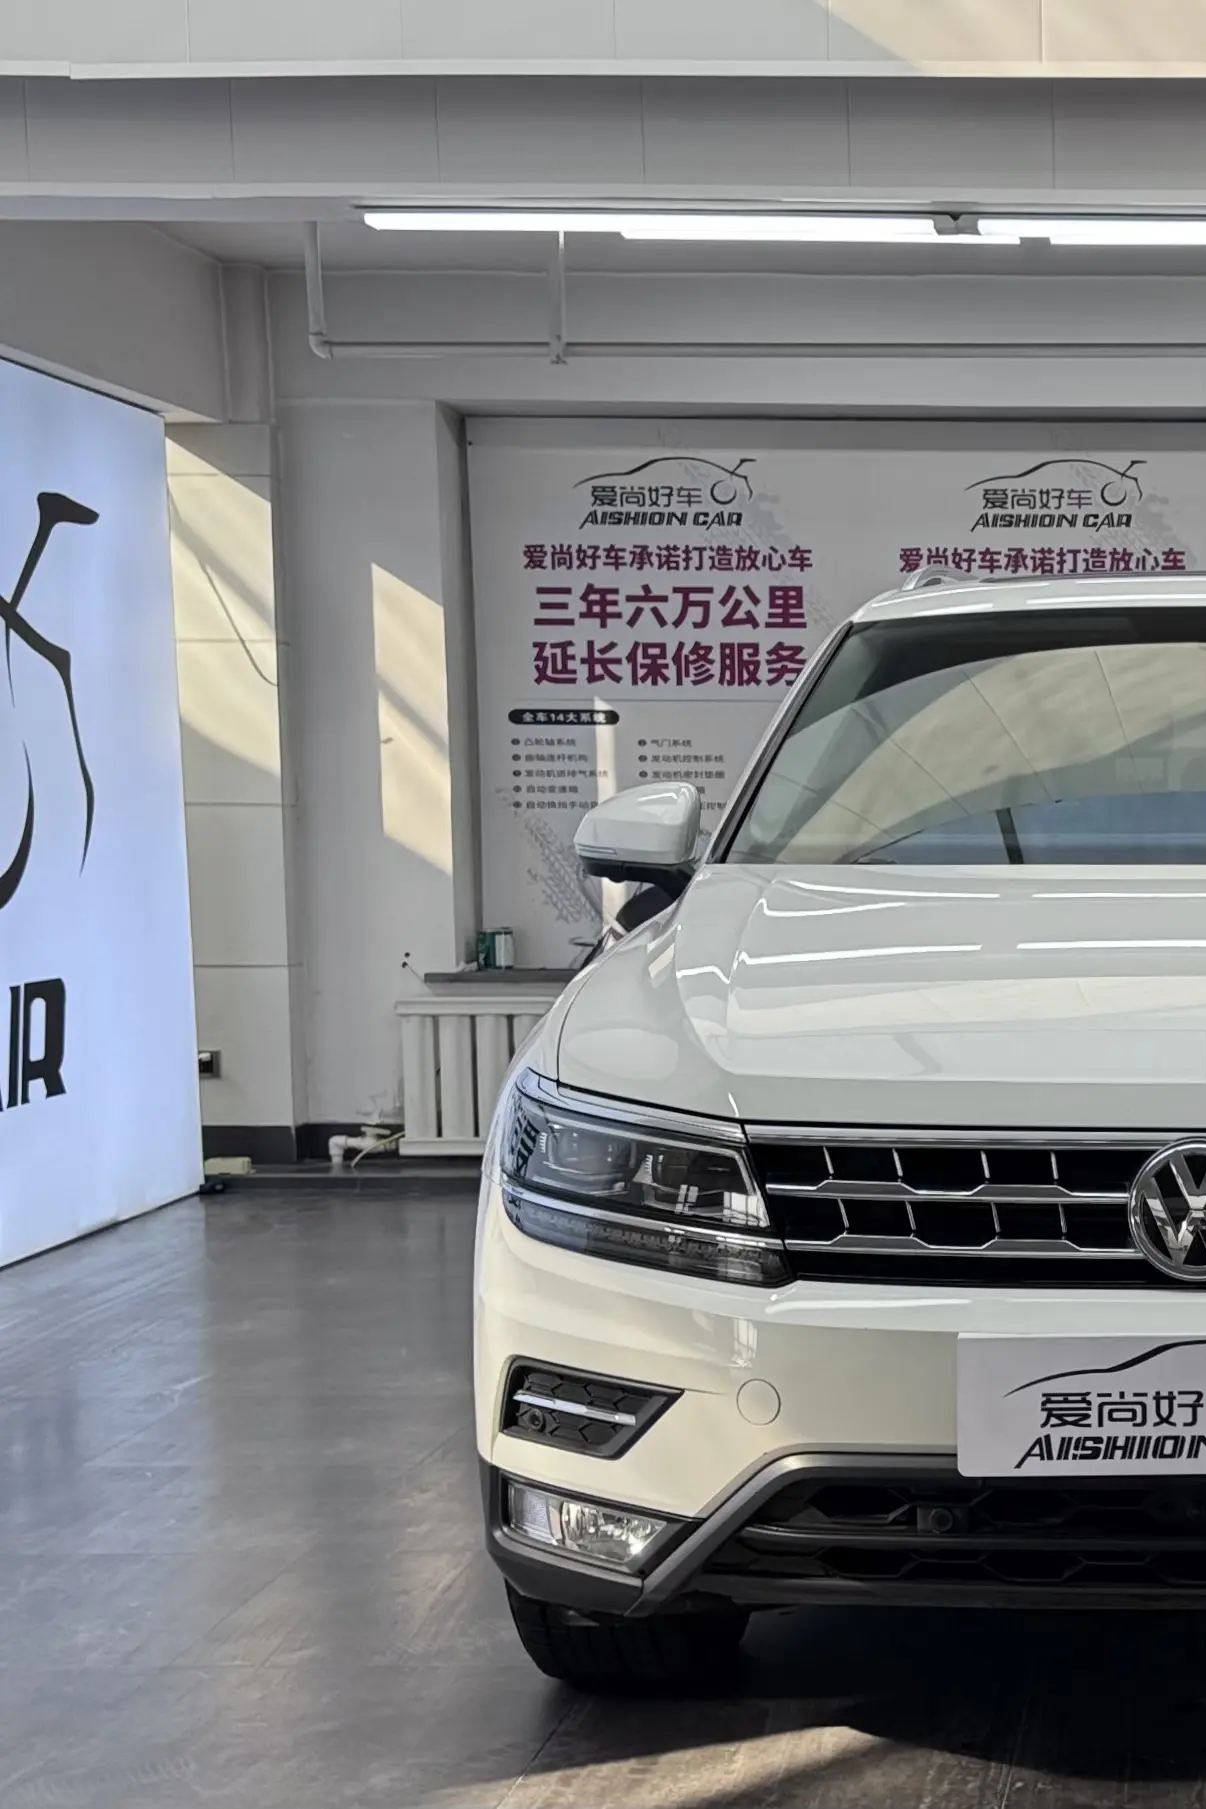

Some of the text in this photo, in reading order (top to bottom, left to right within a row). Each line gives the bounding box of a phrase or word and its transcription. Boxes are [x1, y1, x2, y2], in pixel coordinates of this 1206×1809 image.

[590, 485, 702, 508] 爱尚好车
[982, 488, 1093, 510] 爱尚好车
[579, 510, 743, 530] AISHION CAR
[970, 513, 1132, 532] AISHION CAR
[523, 544, 813, 571] 爱尚好车承诺打造放心车
[899, 547, 1186, 574] 爱尚好车承诺打造放心车
[533, 583, 808, 631] 三年六万公里
[532, 640, 808, 687] 延长保修服务
